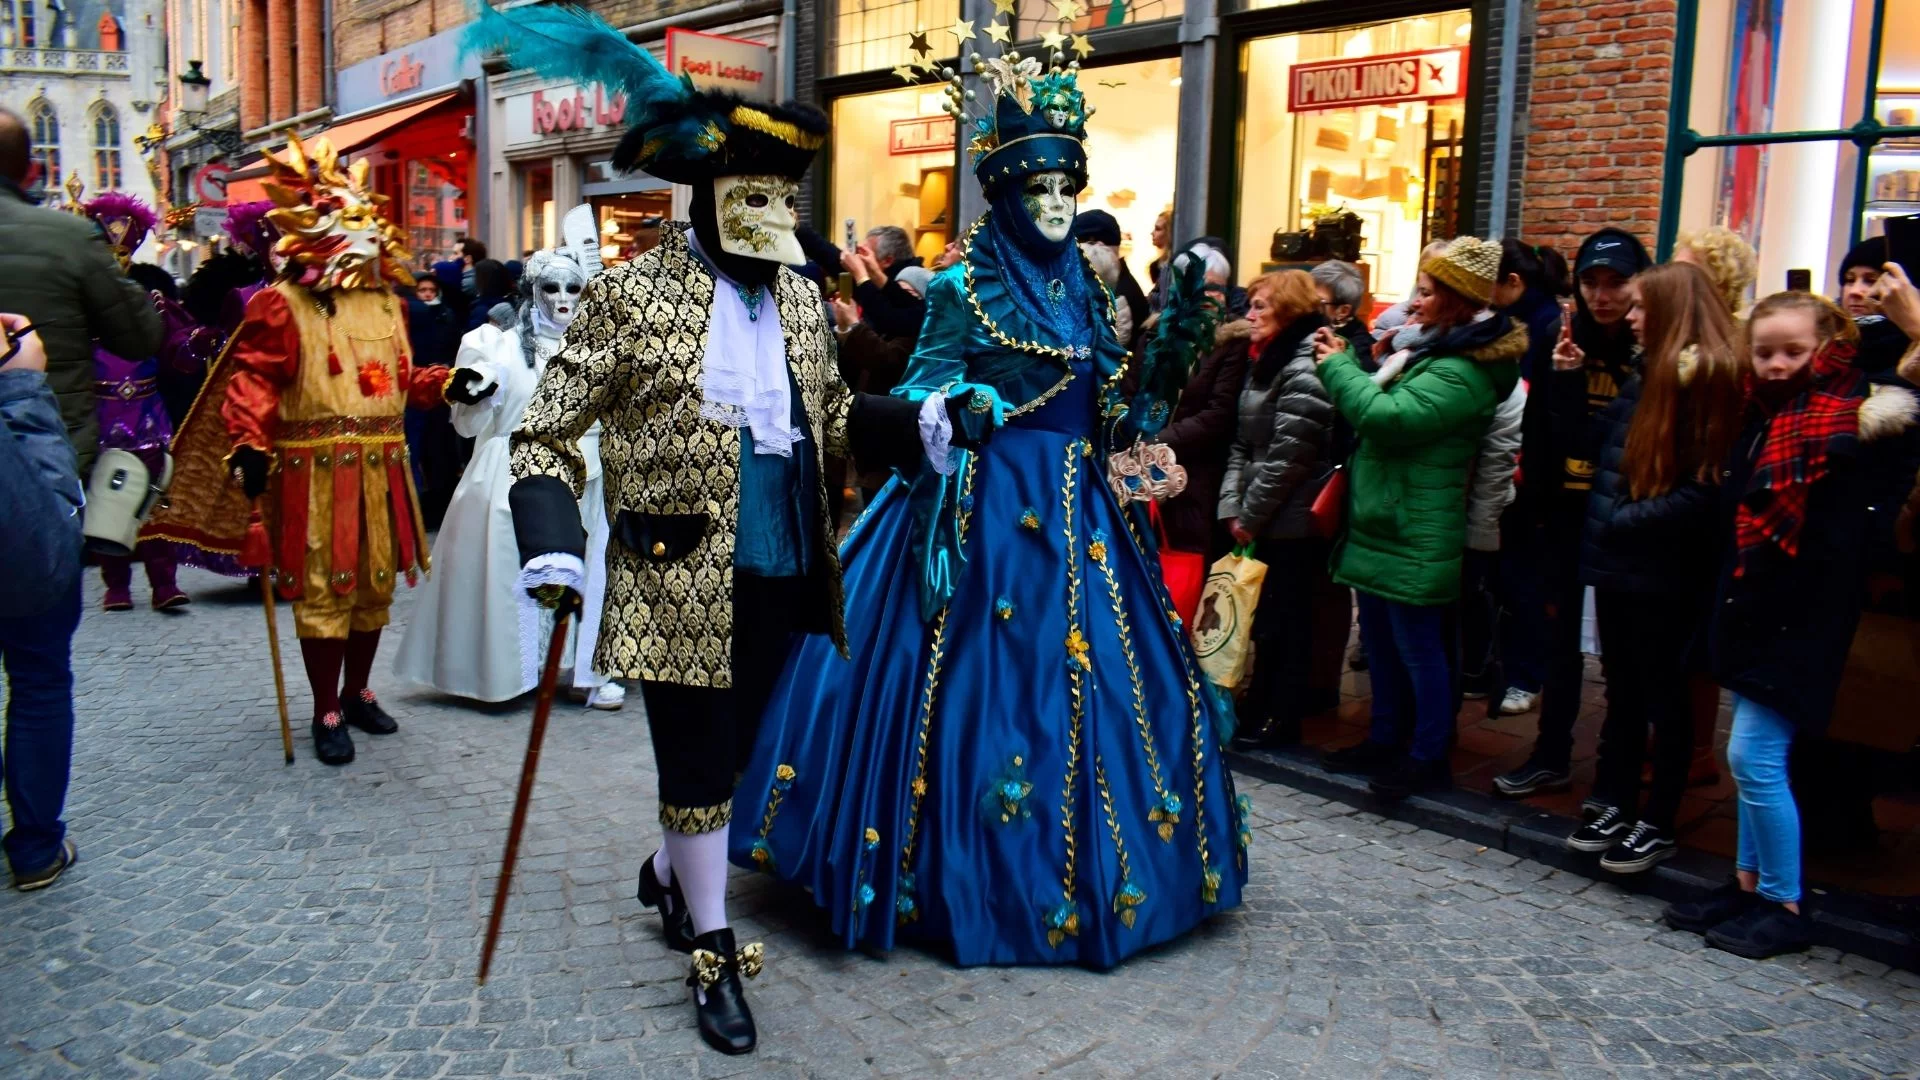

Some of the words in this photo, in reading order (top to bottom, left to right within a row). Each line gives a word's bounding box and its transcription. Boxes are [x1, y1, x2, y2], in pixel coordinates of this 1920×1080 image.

[681, 55, 712, 77] Foot
[717, 60, 764, 84] Locker
[1301, 60, 1416, 103] PIKOLINOS
